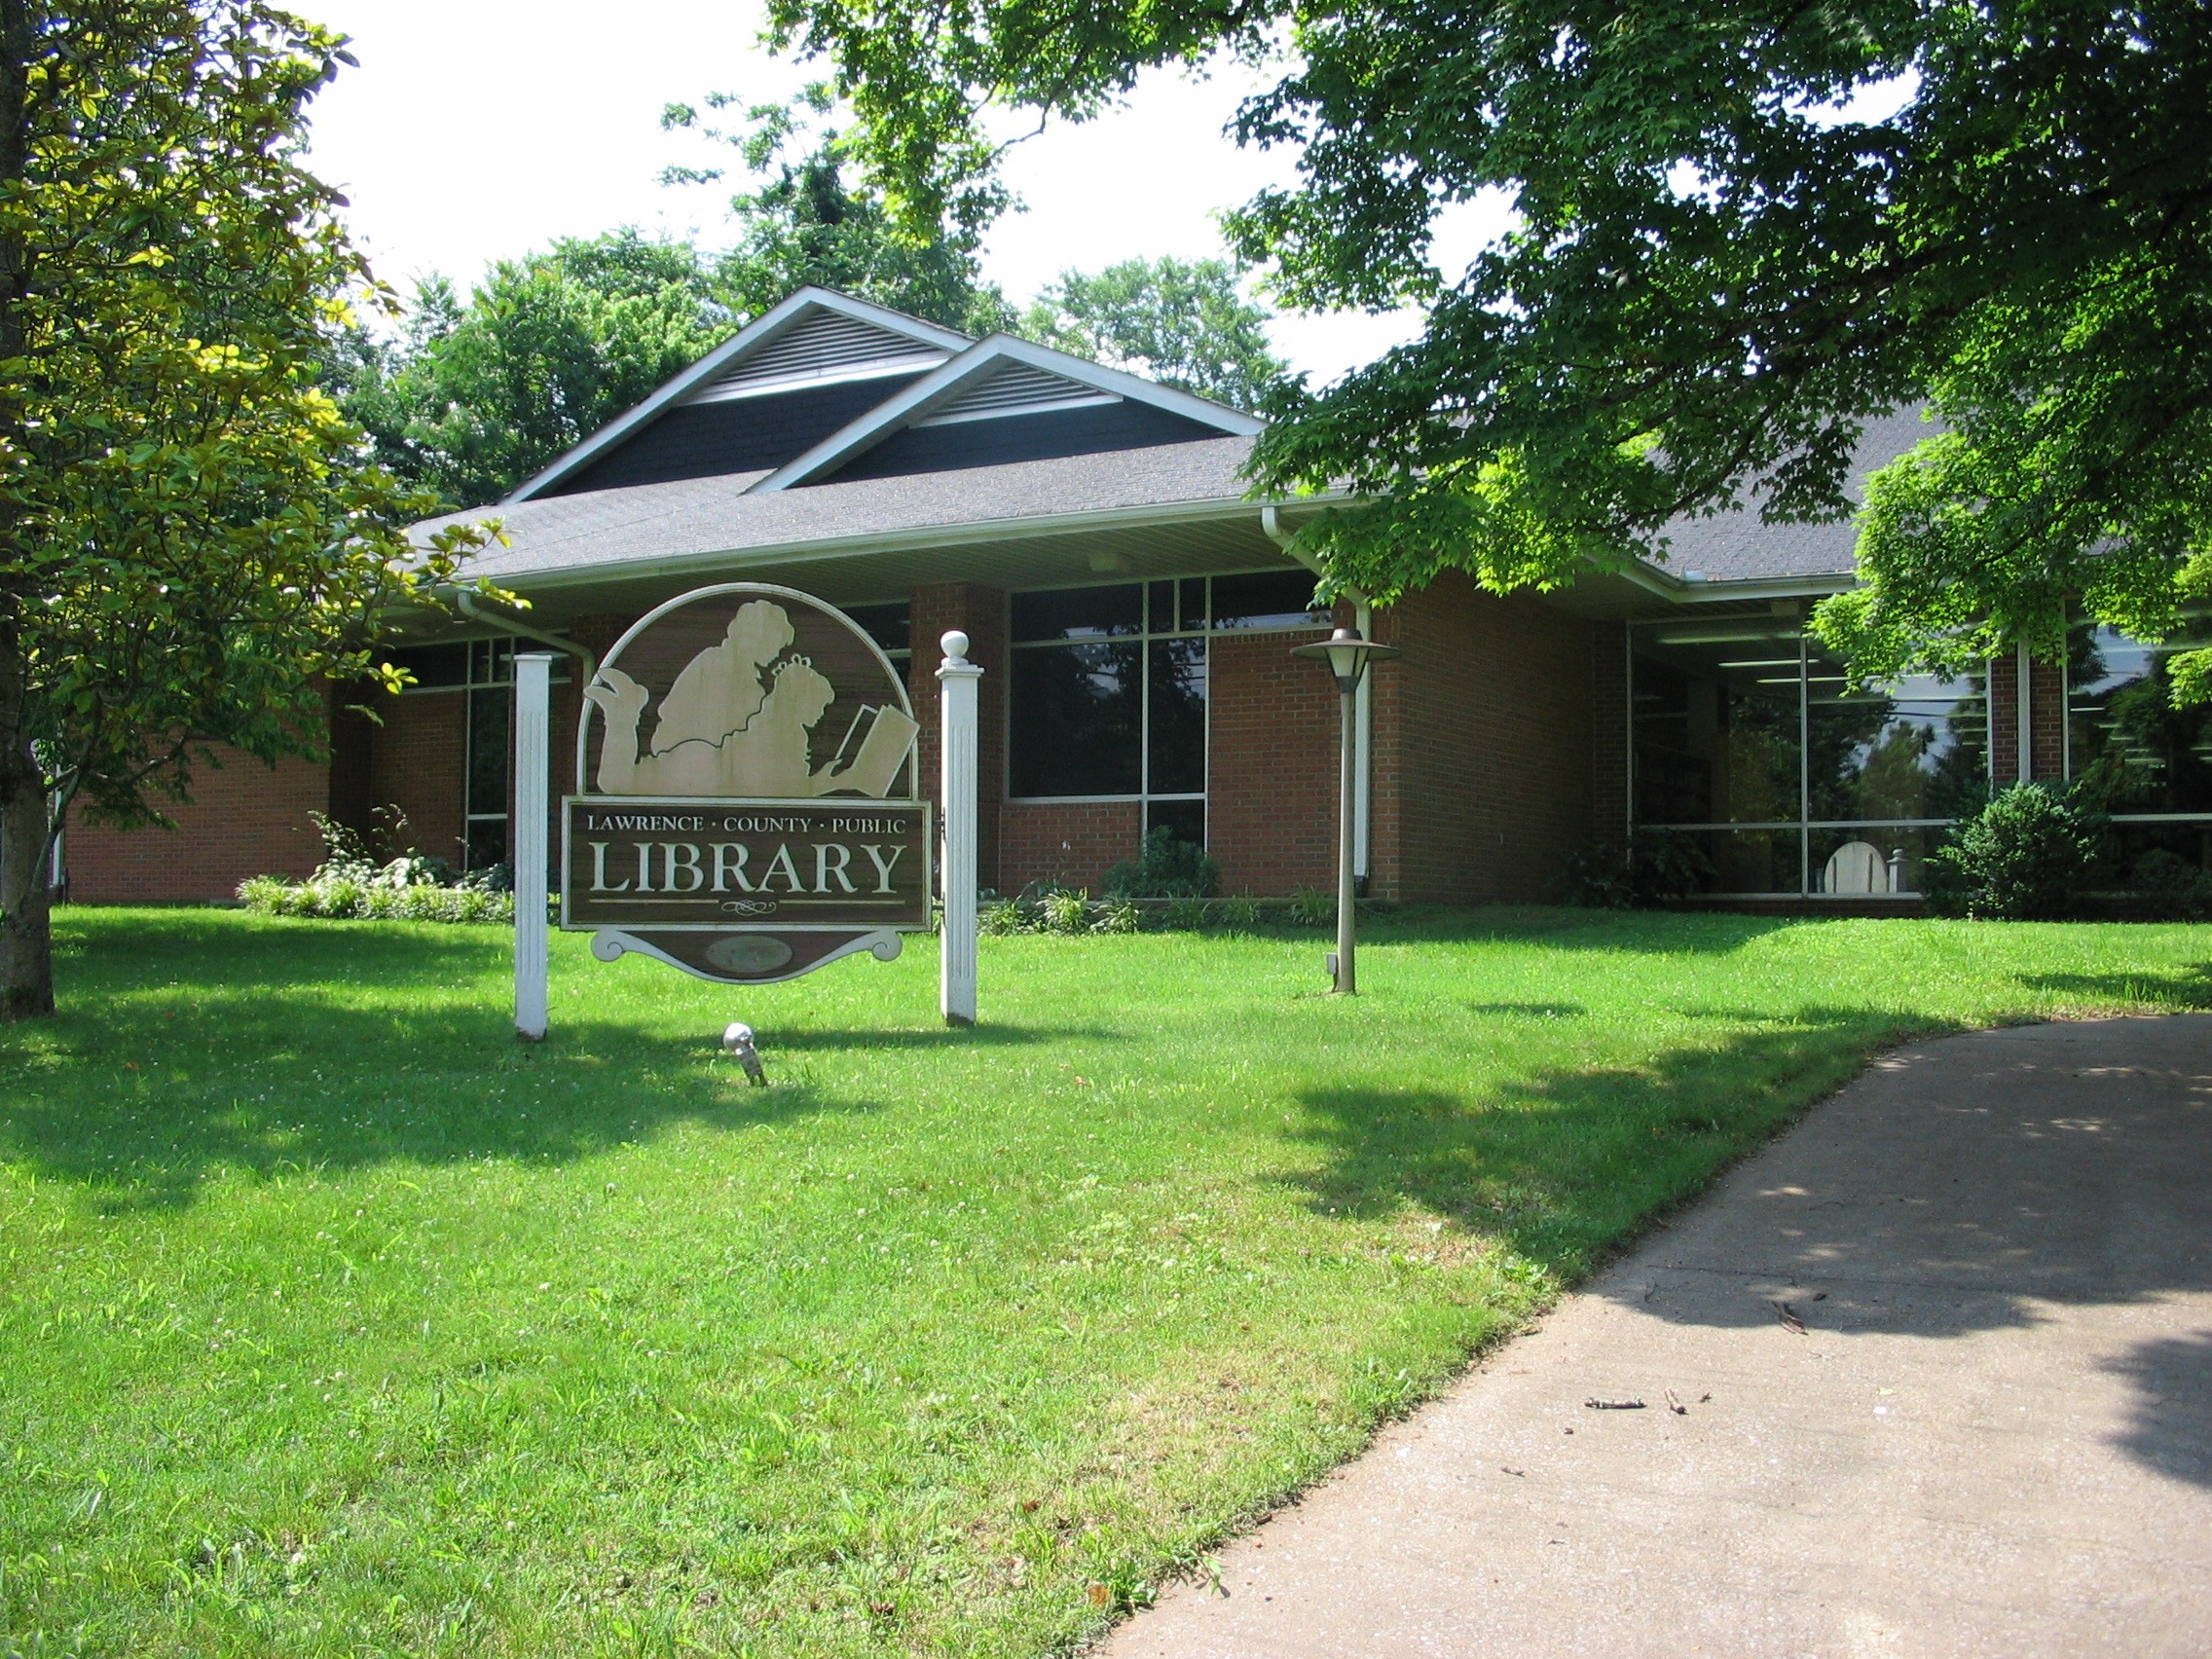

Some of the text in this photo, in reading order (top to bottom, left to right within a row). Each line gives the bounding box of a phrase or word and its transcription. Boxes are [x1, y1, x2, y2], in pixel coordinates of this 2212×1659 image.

[587, 814, 906, 834] LAWRENCE COUNTY PUBLIC
[587, 841, 907, 894] LIBRARY
